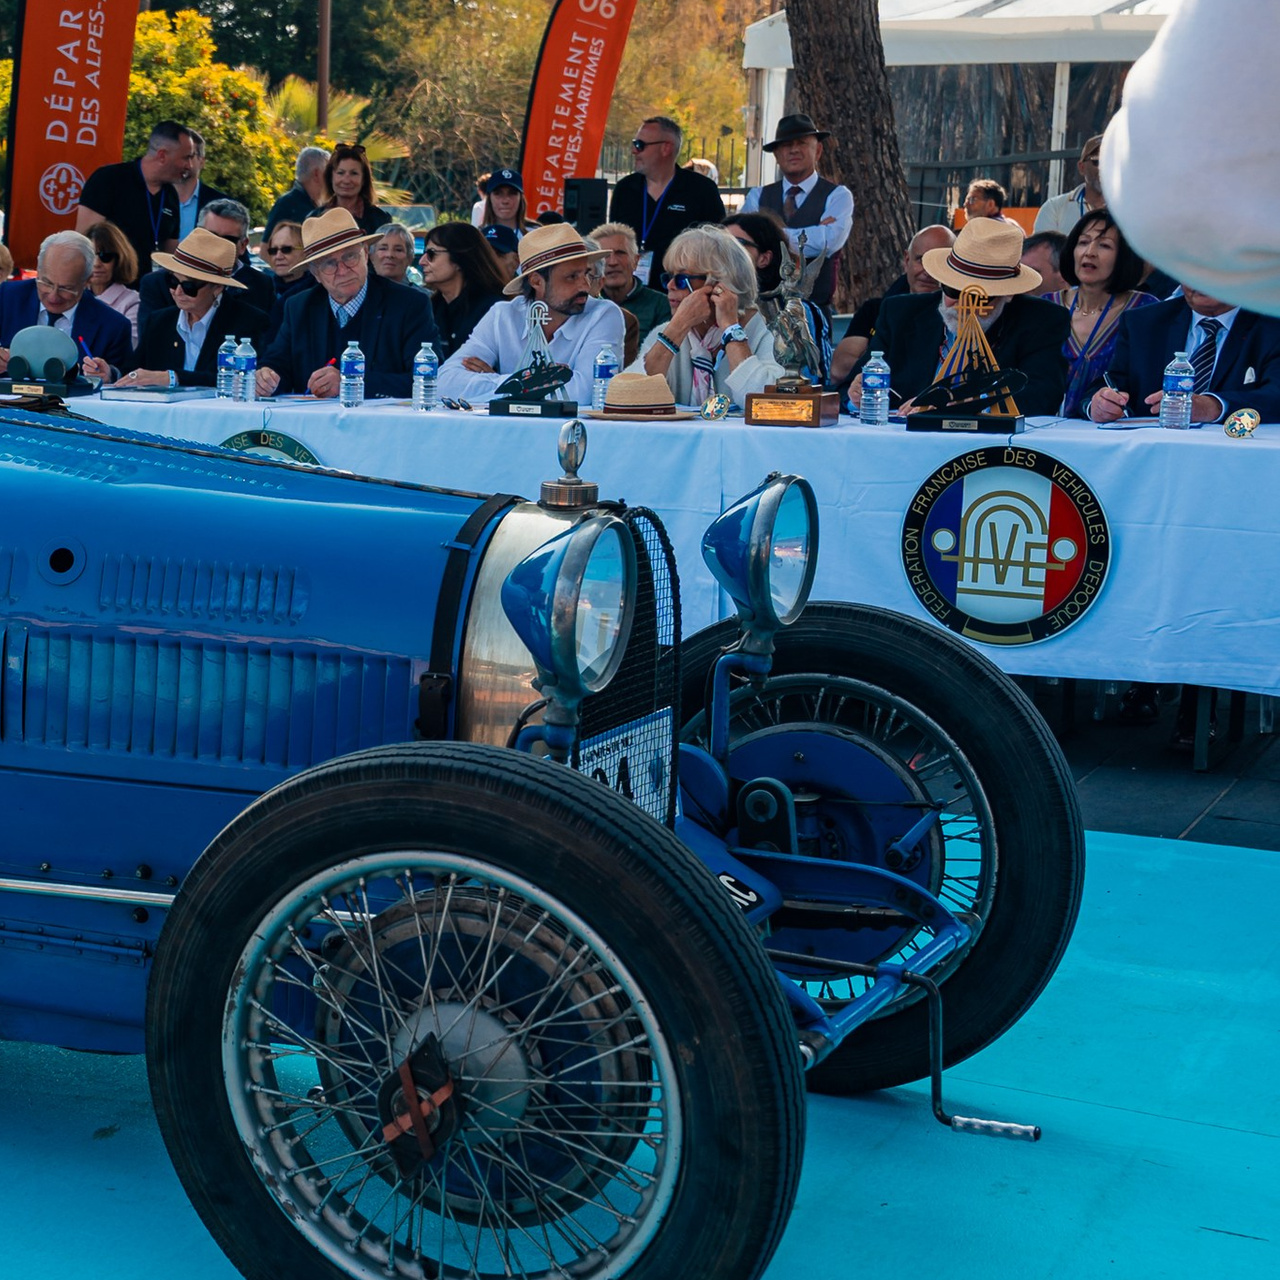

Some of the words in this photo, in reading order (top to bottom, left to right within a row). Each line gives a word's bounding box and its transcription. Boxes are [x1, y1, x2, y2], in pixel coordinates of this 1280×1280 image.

[76, 96, 101, 147] DES
[536, 31, 589, 216] DÉPARTEMENT
[562, 36, 605, 180] ALPES-MARITIMES
[260, 431, 284, 448] DES
[1003, 449, 1037, 468] DES
[912, 451, 988, 516] FRANÇAISE
[1050, 464, 1106, 545] VEHICULES
[904, 527, 952, 620] FEDERATION
[1047, 560, 1105, 630] D'EPOQUE
